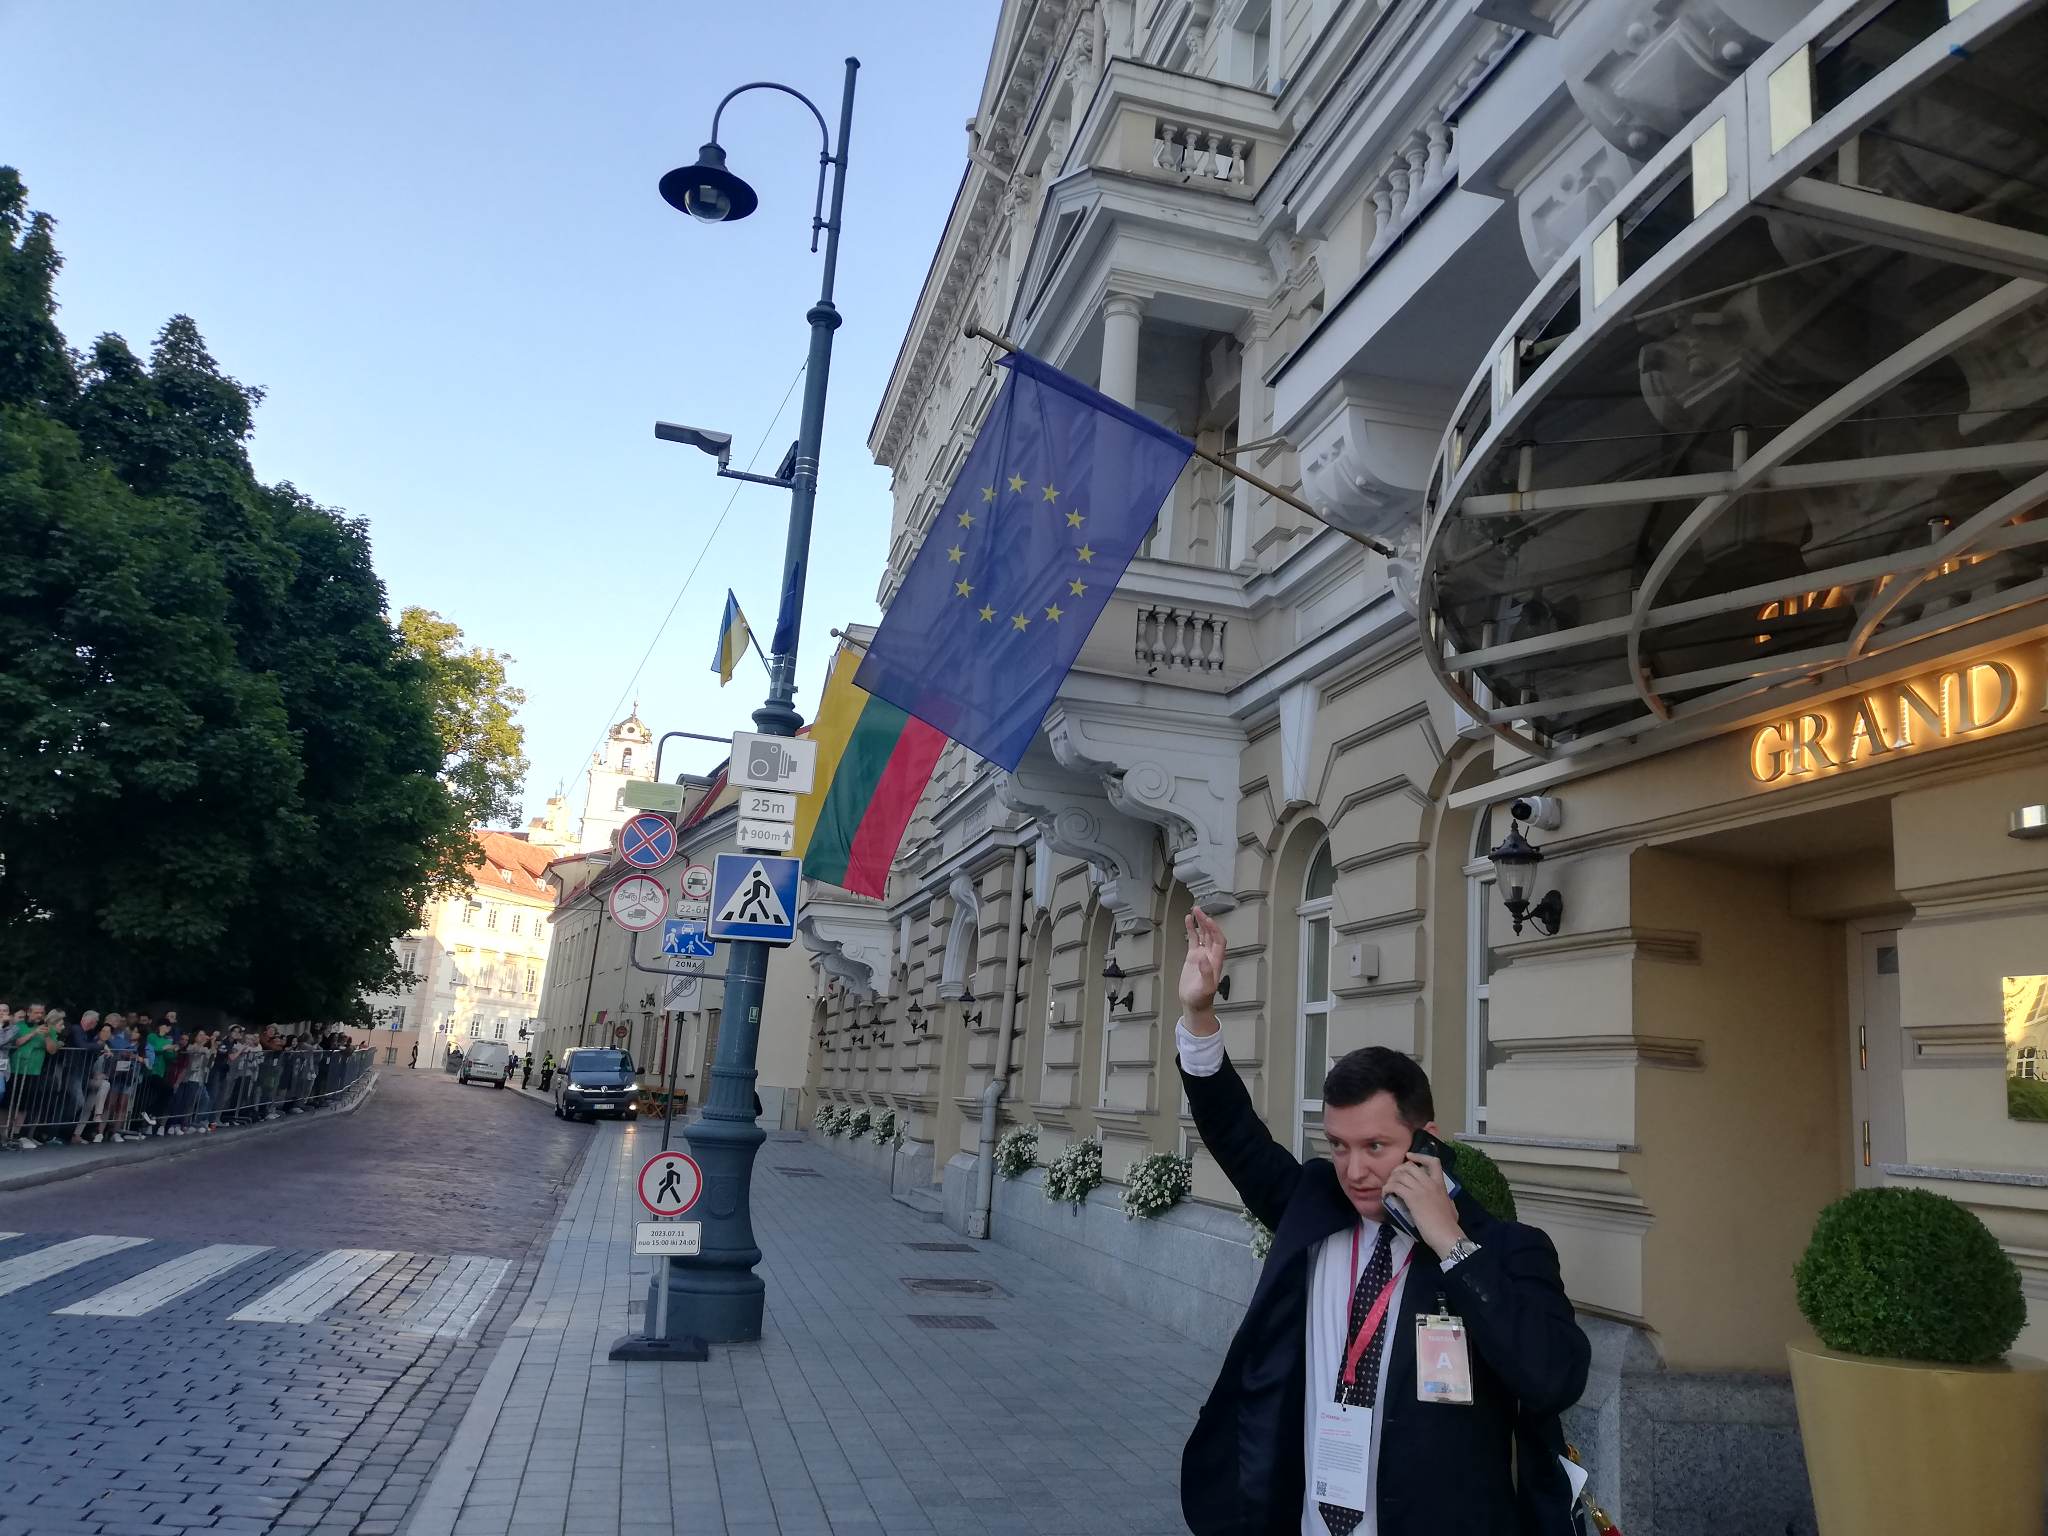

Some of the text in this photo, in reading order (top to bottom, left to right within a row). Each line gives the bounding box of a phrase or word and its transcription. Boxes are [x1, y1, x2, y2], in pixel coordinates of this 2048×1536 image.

[1751, 660, 2018, 782] GRAND
[675, 960, 697, 968] ZONA
[1437, 1352, 1453, 1369] A
